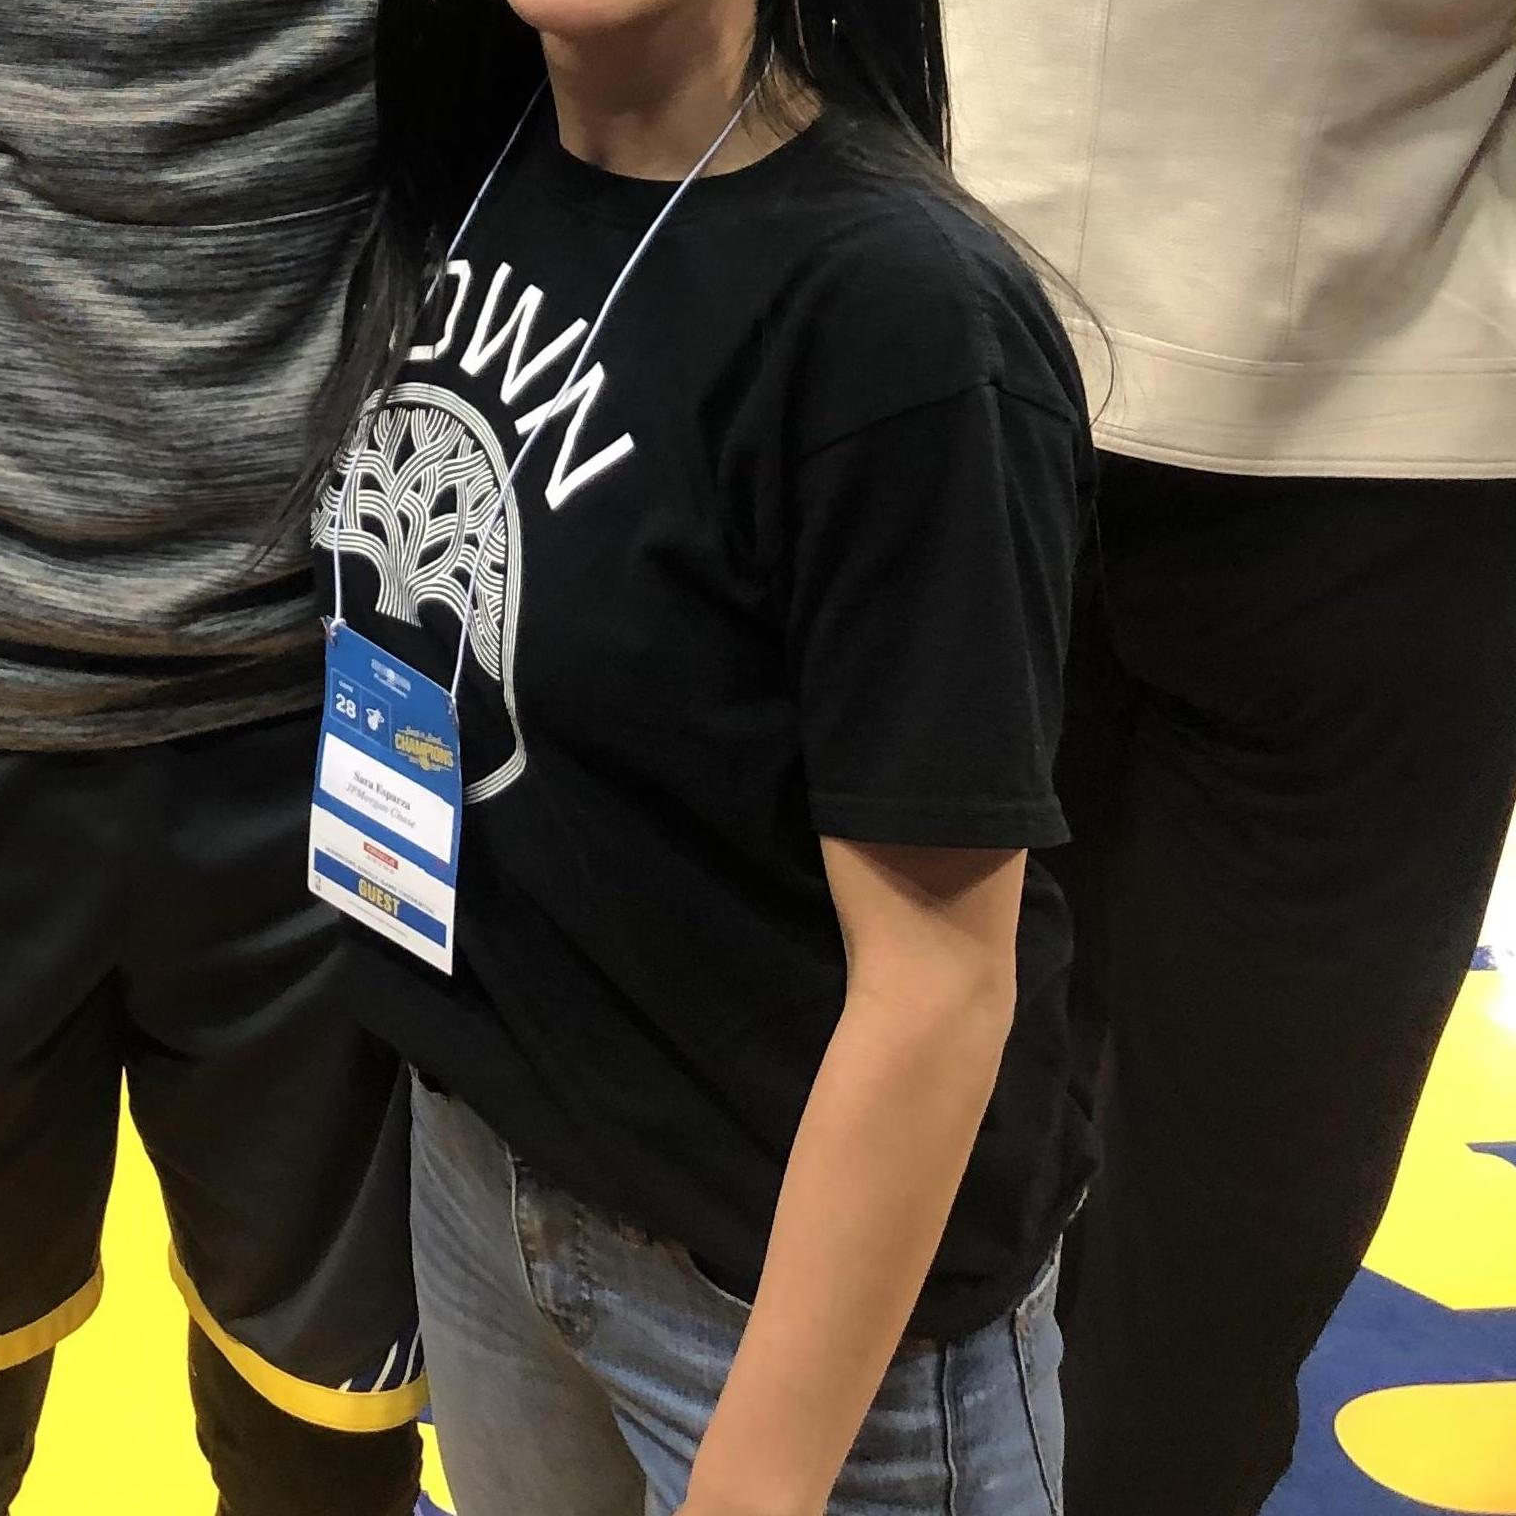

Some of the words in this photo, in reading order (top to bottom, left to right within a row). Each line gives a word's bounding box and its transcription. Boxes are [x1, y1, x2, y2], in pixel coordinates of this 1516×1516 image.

[399, 259, 634, 511] OWN
[335, 692, 357, 720] 28
[394, 733, 454, 768] CHAMPIONS
[358, 878, 401, 918] GUEST
